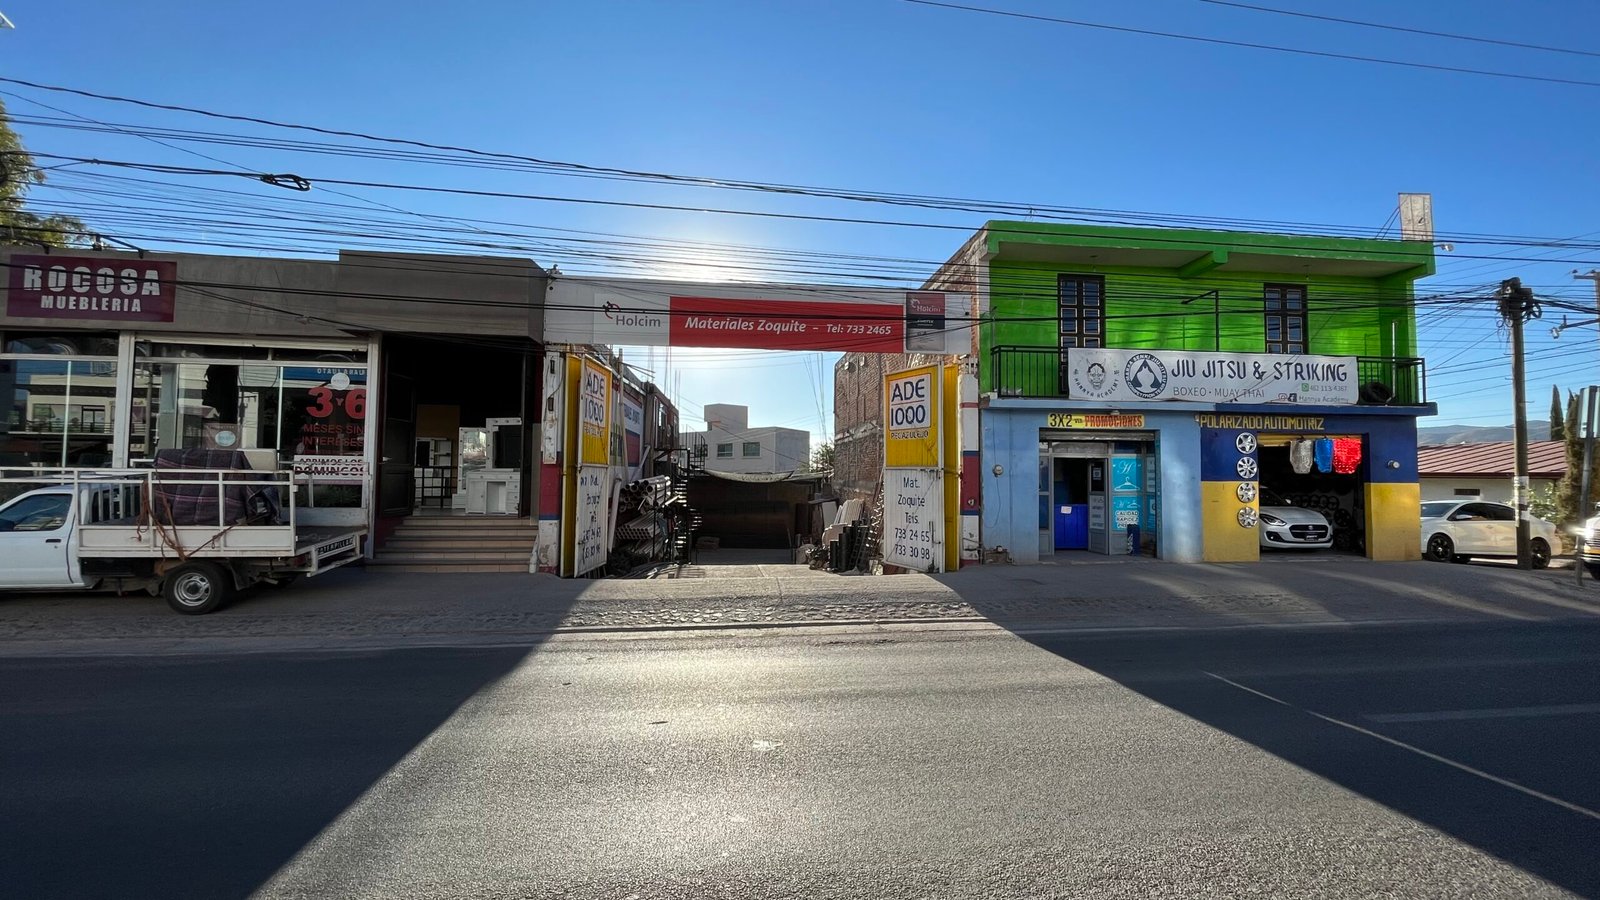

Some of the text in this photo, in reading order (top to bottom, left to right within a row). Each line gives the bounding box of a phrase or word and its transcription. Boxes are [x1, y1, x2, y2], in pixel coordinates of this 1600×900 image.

[23, 264, 161, 296] ROCOSA
[40, 295, 142, 313] MUEBLERIA
[615, 314, 661, 328] Holcim
[684, 316, 755, 331] Materiales
[756, 318, 807, 335] Zoquite
[826, 323, 844, 334] Tel:
[846, 325, 864, 335] 733
[866, 325, 892, 336] 2465
[1171, 359, 1348, 382] JIU JITSU & STRIKING
[586, 372, 605, 397] ADE
[890, 377, 925, 402] ADE
[1173, 386, 1265, 399] BOXEO MUAY THAI
[306, 386, 334, 418] 3
[344, 388, 367, 420] 6
[890, 404, 926, 427] 1000
[1049, 413, 1072, 427] 3X2
[1084, 415, 1143, 428] PROMOCIONES
[1200, 415, 1325, 431] POLARIZADO AUTOMOTRIZ
[303, 423, 364, 435] MESES SIN
[903, 476, 920, 489] Mat.
[897, 493, 926, 510] Zoquite
[894, 527, 930, 543] 733 24 65
[894, 543, 931, 560] 733 30 98
